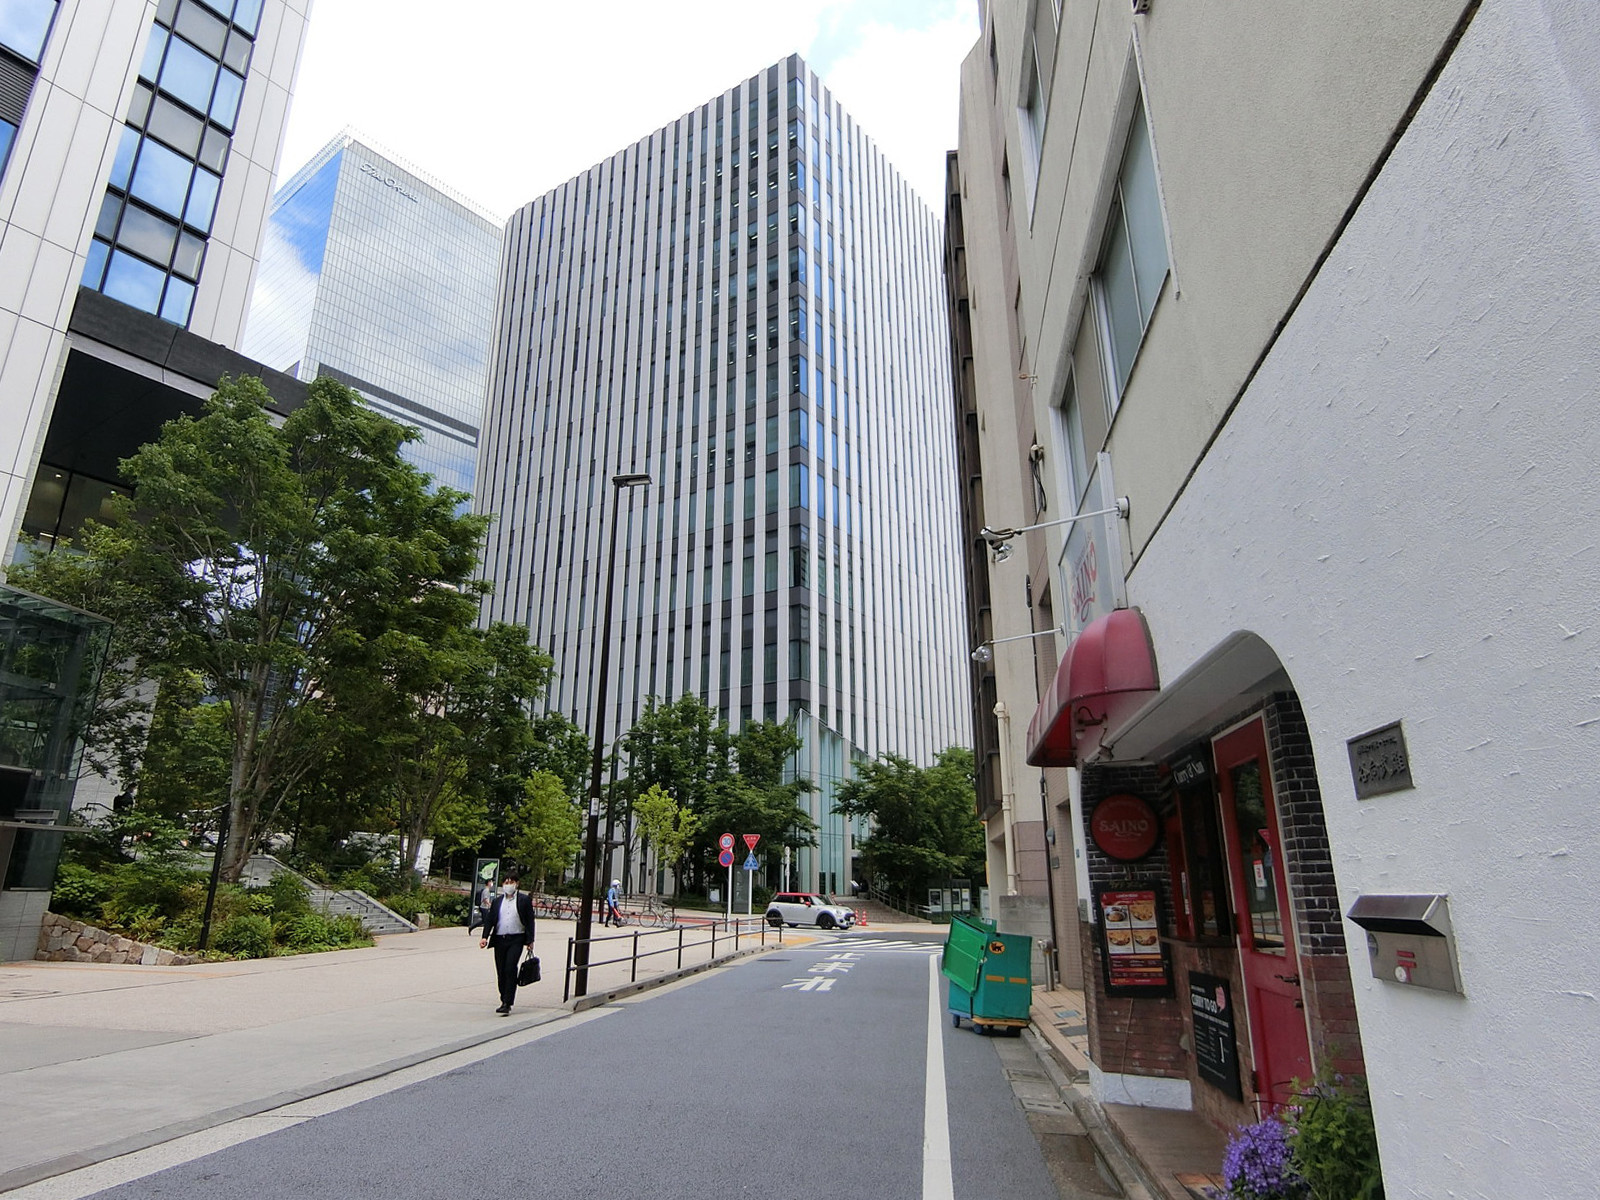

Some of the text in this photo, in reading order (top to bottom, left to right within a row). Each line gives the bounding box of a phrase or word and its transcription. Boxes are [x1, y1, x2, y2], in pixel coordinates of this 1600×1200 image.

[1099, 819, 1149, 833] SAINO
[722, 838, 732, 846] 30
[781, 952, 865, 991] 止まれ
